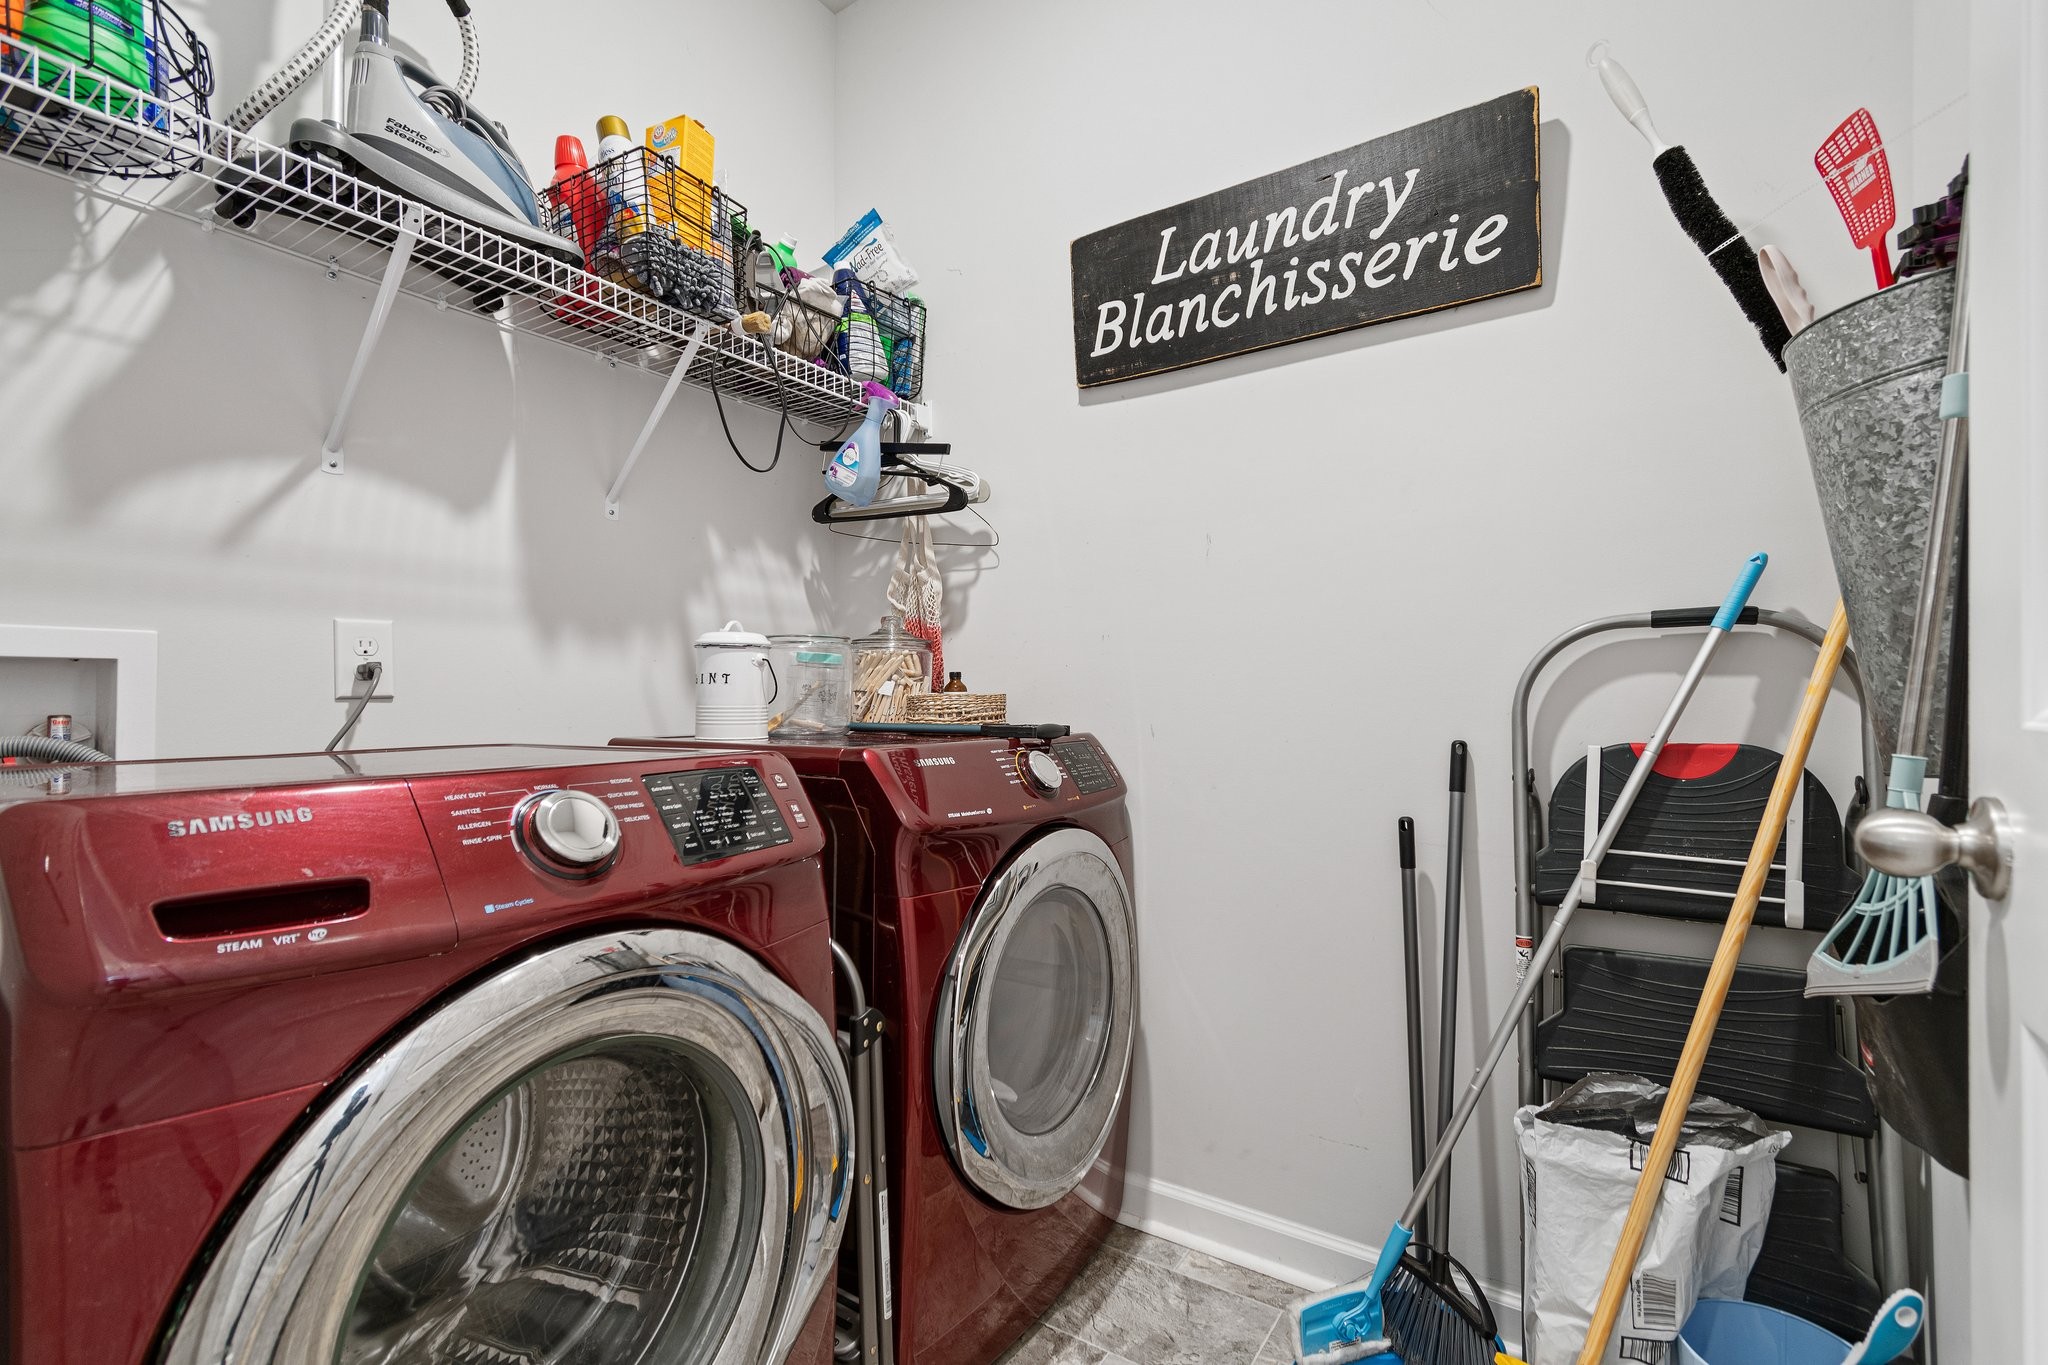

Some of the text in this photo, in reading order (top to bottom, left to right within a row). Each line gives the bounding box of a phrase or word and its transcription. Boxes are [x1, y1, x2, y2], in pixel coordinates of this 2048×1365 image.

[386, 117, 427, 141] Fabric
[384, 125, 440, 154] Steamer
[1151, 168, 1421, 286] Laundry
[1089, 212, 1509, 358] Blanchisserie
[914, 756, 956, 767] SAMSUNG
[168, 807, 313, 837] SAMSUNG
[450, 808, 481, 817] SANITIZE
[457, 821, 492, 831] ALLERGEN
[494, 898, 534, 911] Steam Cycles
[217, 939, 262, 953] STEAM
